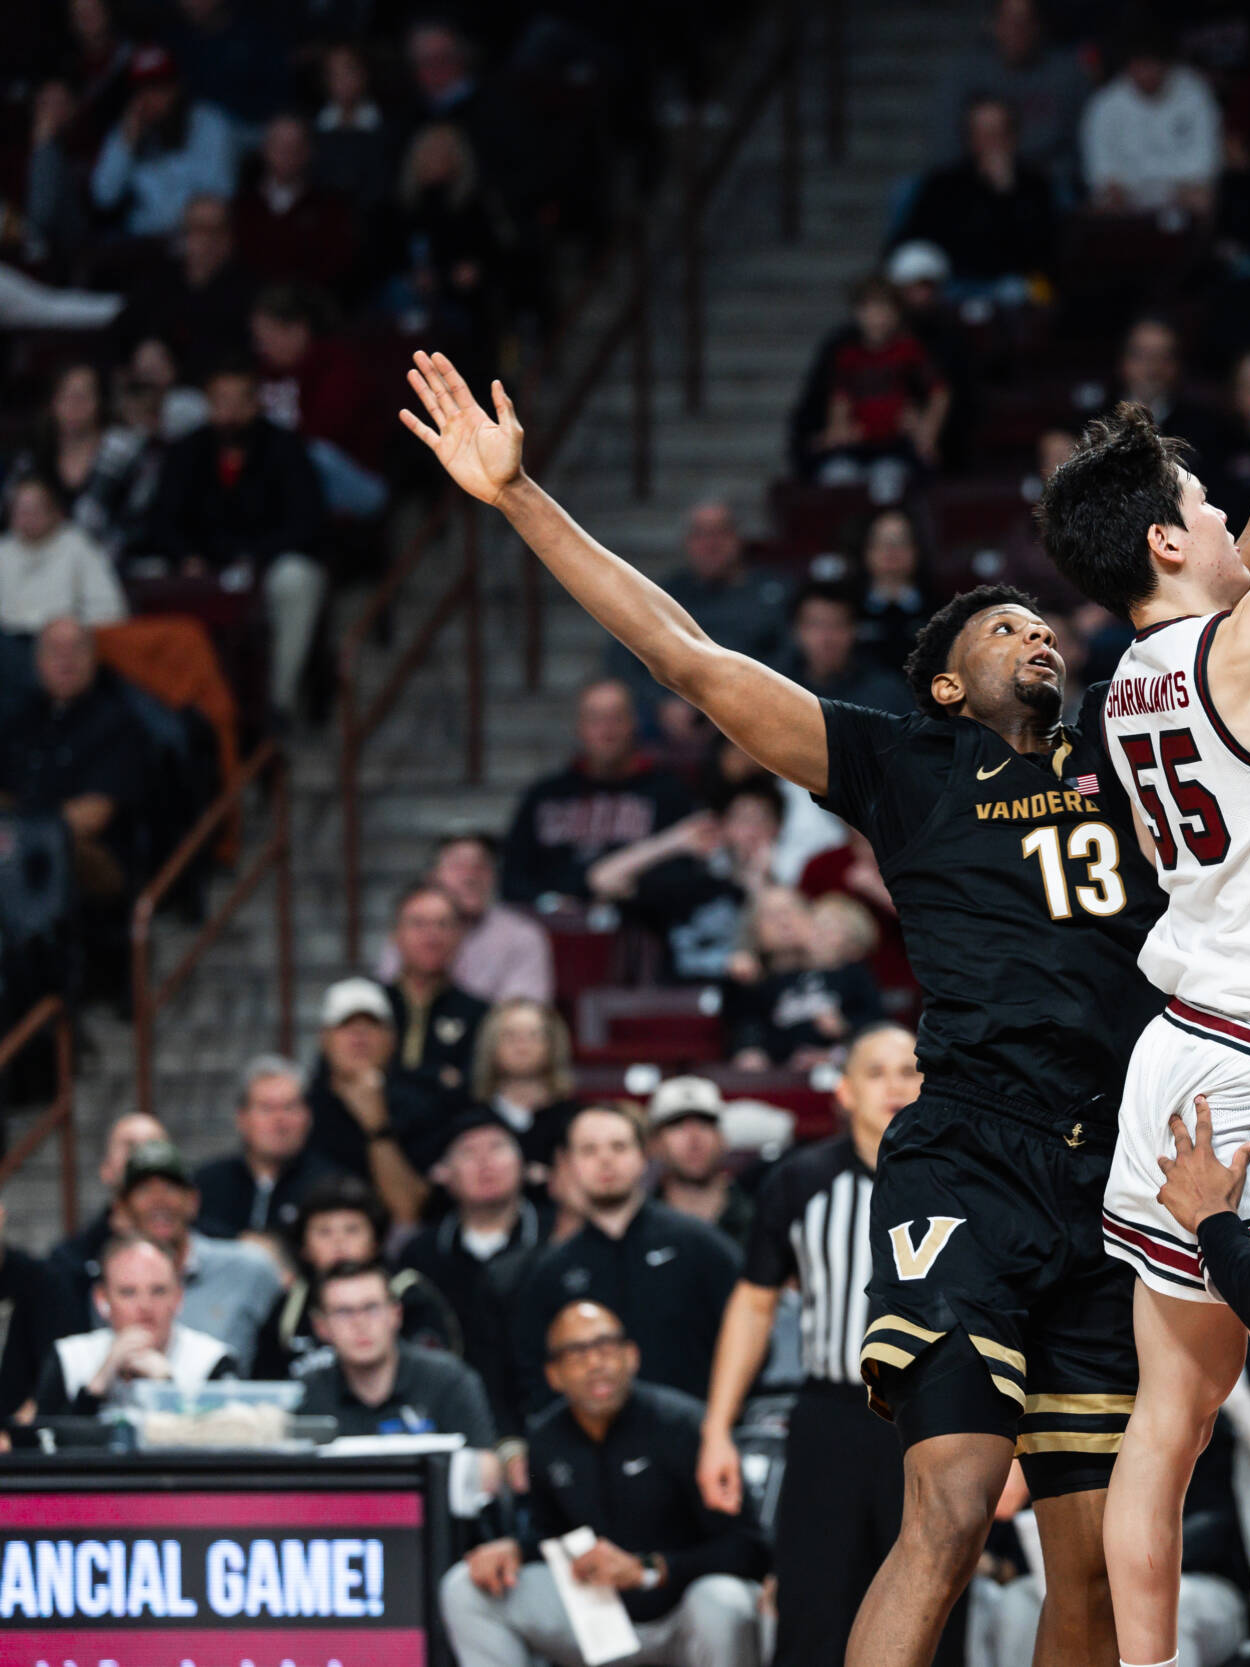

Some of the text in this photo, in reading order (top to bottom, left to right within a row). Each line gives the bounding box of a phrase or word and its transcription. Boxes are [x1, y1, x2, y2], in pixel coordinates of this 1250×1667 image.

[1118, 727, 1232, 871] 55
[1021, 821, 1128, 921] 13
[888, 1216, 967, 1280] V
[0, 1539, 384, 1618] ANCIAL GAME!
